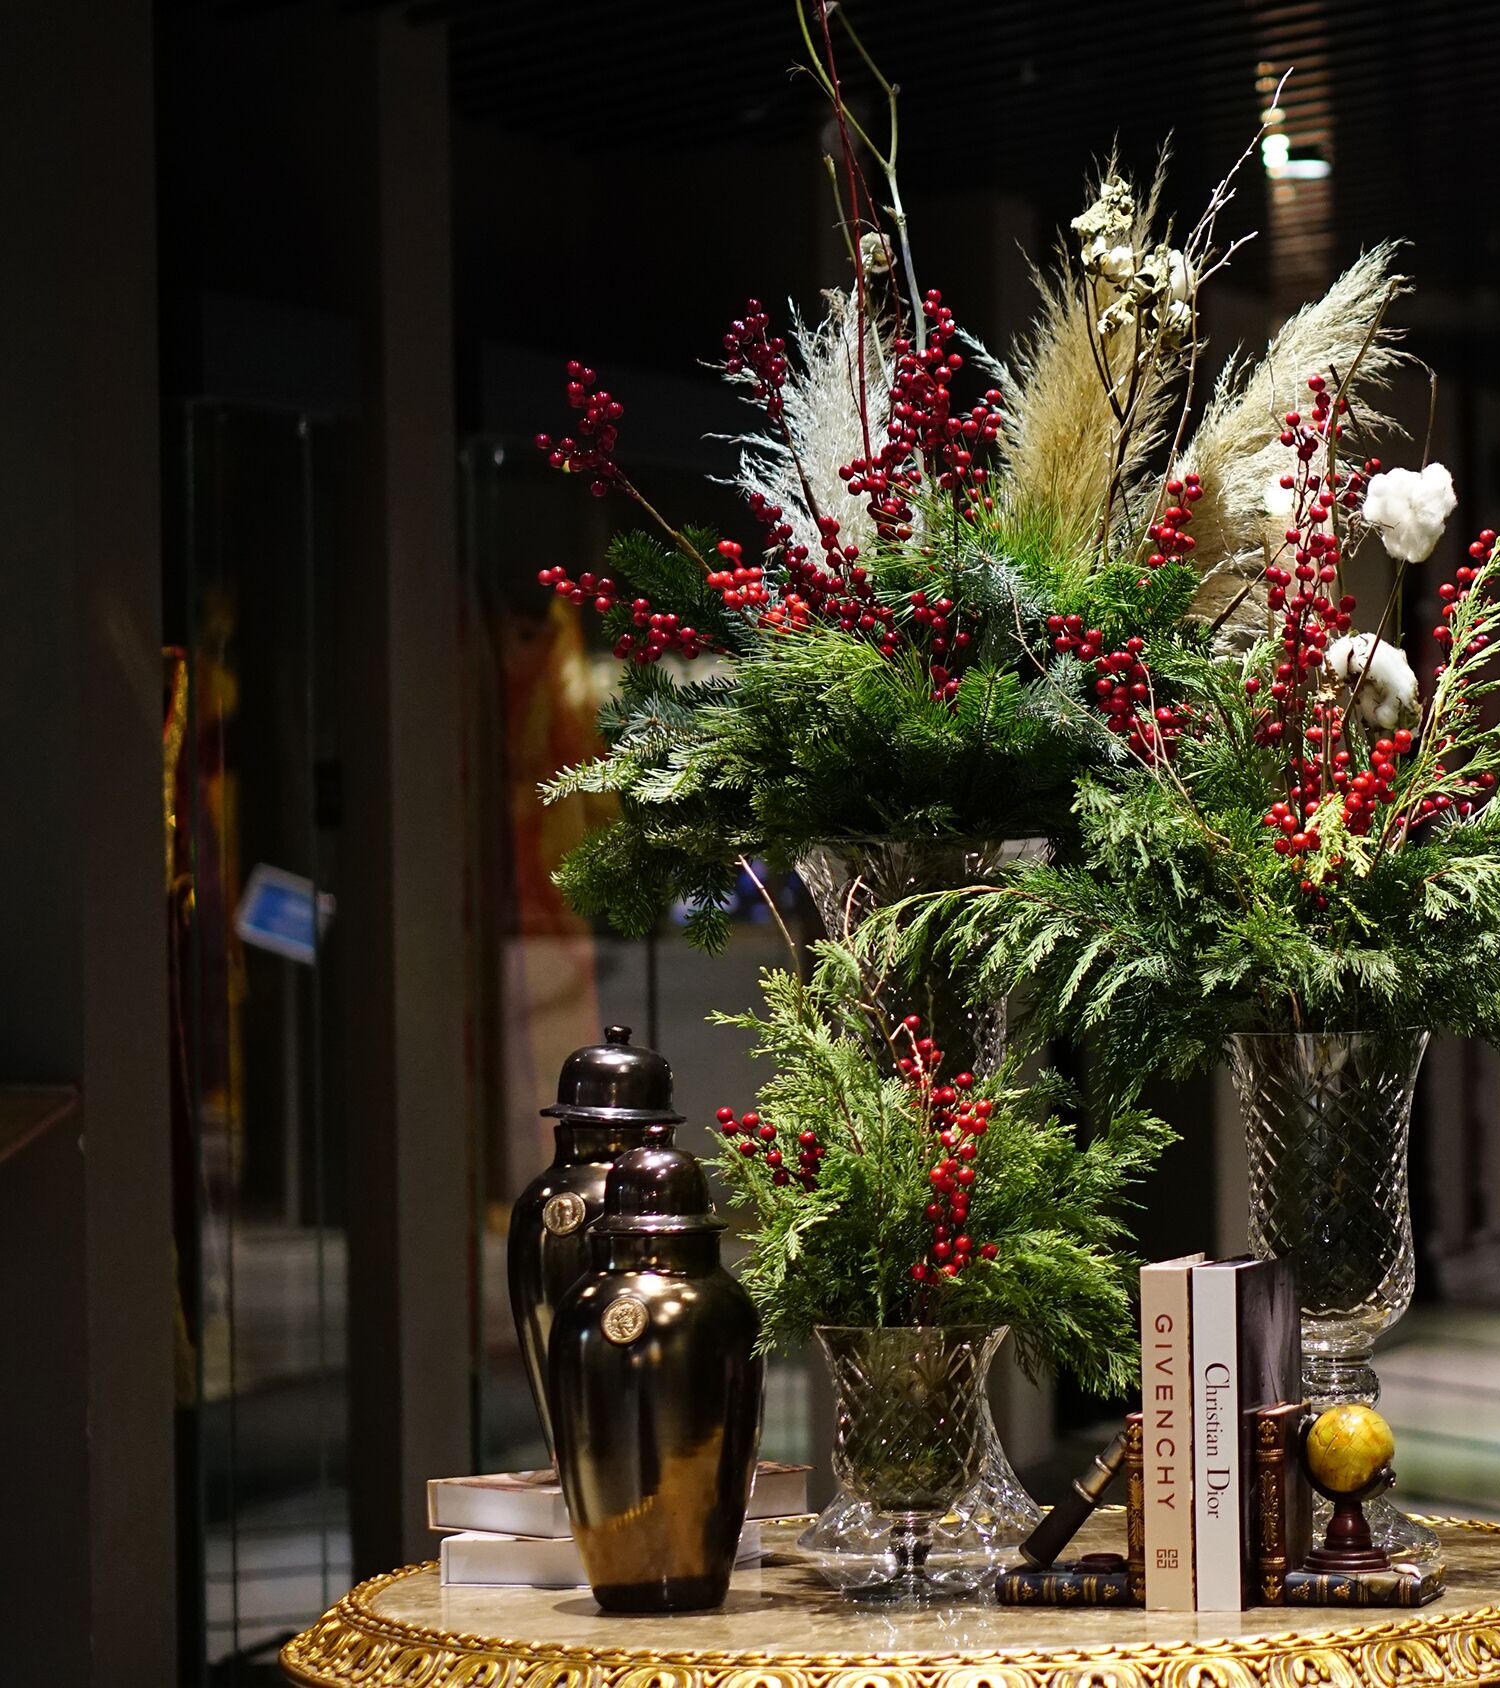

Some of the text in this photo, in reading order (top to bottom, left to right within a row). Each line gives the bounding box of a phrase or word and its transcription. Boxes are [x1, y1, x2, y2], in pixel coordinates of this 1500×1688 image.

[1154, 1313, 1177, 1511] GIVENCHY
[1204, 1362, 1231, 1519] Christian Dior
